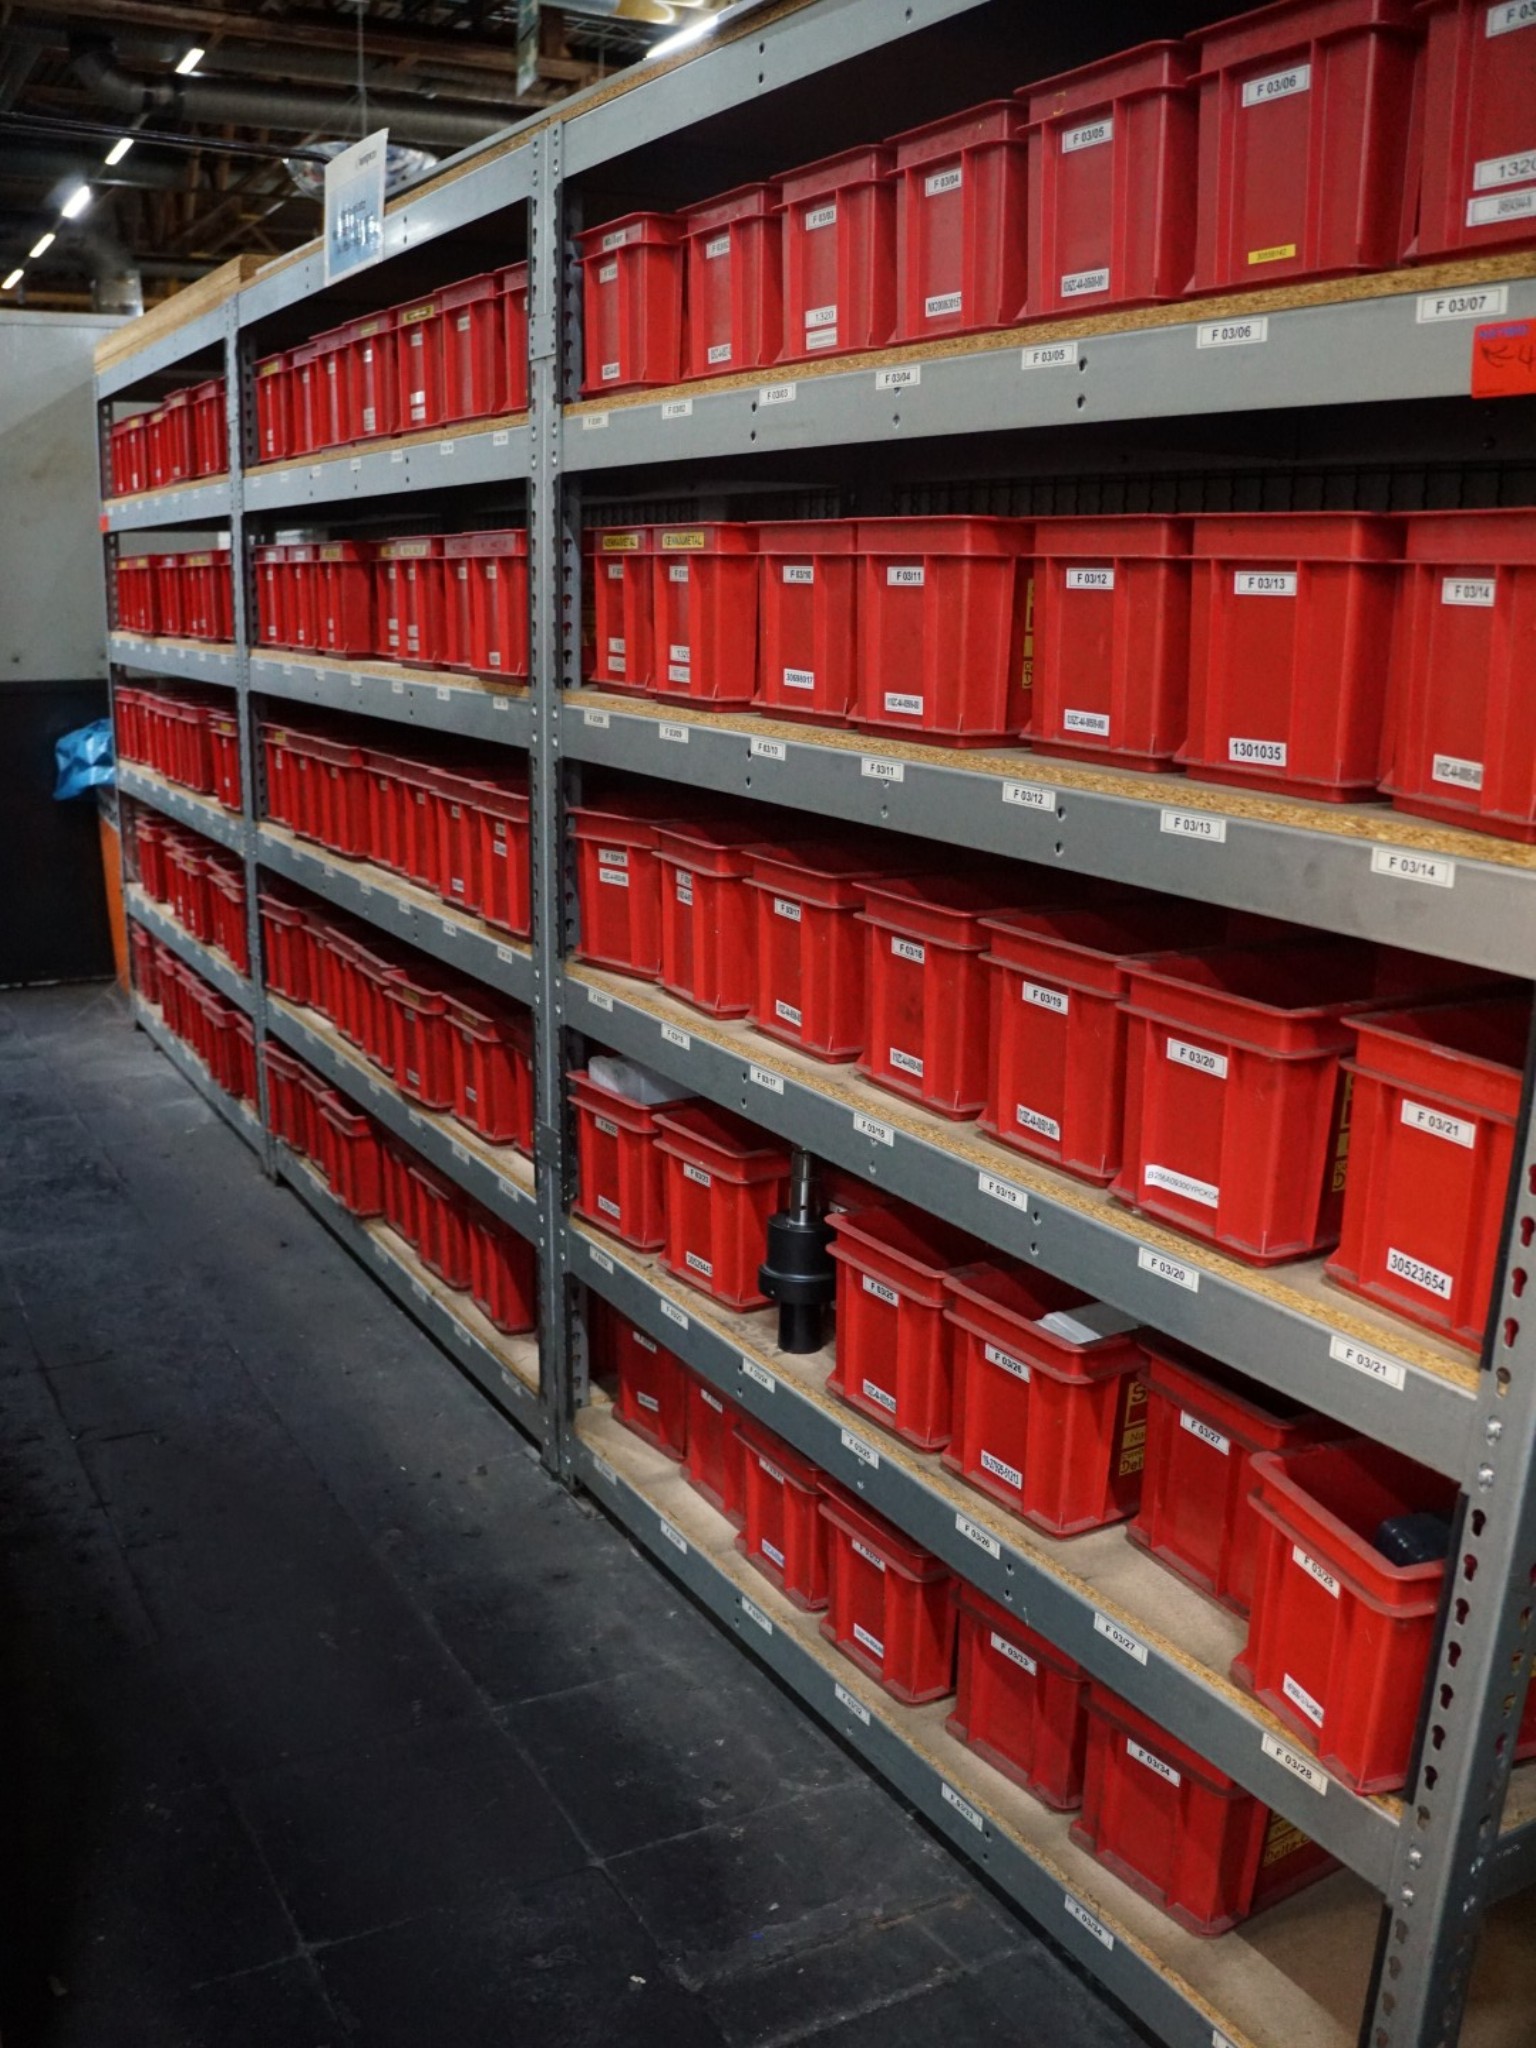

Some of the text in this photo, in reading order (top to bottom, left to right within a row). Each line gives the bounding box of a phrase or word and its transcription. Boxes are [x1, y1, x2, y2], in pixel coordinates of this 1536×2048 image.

[1506, 8, 1514, 23] F
[1257, 75, 1297, 97] F 03/06
[1082, 127, 1105, 142] 03/05
[941, 174, 959, 187] 03/04
[1436, 297, 1486, 314] F 03/07
[1221, 326, 1251, 341] 03/06
[1042, 350, 1065, 362] 03/05
[892, 372, 911, 383] 03/04
[796, 570, 812, 580] 03/10
[903, 571, 922, 582] 03/11
[1085, 574, 1106, 585] 03/12
[1258, 577, 1285, 590] 03/13
[1454, 585, 1489, 599] F 03/14
[1233, 743, 1282, 761] 1301035
[877, 765, 894, 776] 03/11
[1021, 791, 1043, 804] 03/12
[1174, 817, 1211, 834] F 03/13
[1388, 856, 1435, 877] F 03/14
[786, 905, 800, 916] 03/17
[906, 945, 923, 959] 03/18
[1040, 991, 1062, 1007] 03/19
[1180, 1048, 1215, 1068] F 03/20
[867, 1122, 885, 1138] 03/18
[1417, 1111, 1459, 1136] F 03/21
[996, 1184, 1016, 1202] 03/19
[1151, 1258, 1185, 1282] F 03/20
[1391, 1253, 1446, 1292] 30523654
[877, 1284, 895, 1300] 03/25
[1001, 1355, 1022, 1374] 03/26
[1346, 1348, 1387, 1376] F 03/21
[1190, 1419, 1221, 1443] F 03/27
[971, 1528, 990, 1548] 03/26
[1303, 1555, 1334, 1589] F 03/28
[1105, 1624, 1135, 1652] F 03/27
[1000, 1643, 1007, 1652] F
[1138, 1749, 1171, 1777] F 03/34
[1275, 1747, 1313, 1780] F 03/28
[1082, 1912, 1103, 1937] 03/34
